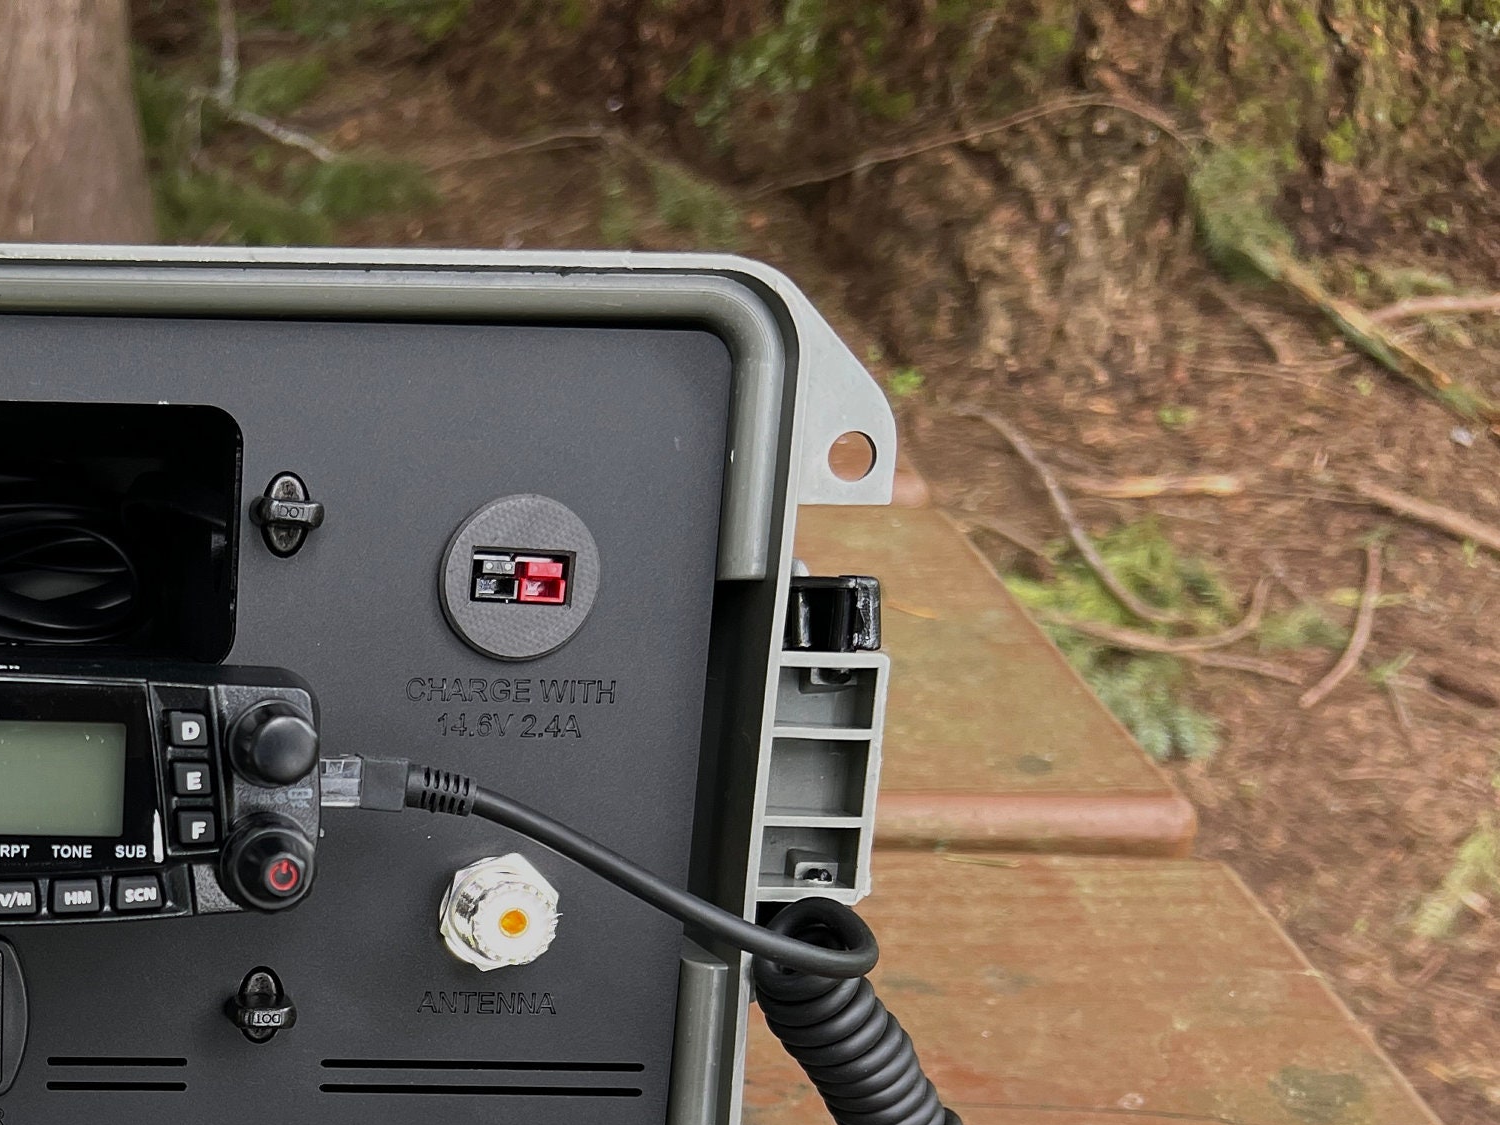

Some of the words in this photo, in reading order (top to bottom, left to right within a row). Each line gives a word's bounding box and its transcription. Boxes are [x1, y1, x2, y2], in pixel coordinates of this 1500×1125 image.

[405, 677, 532, 703] CHARGE
[540, 680, 617, 704] WITH
[181, 720, 201, 741] D
[437, 713, 514, 737] 14.6V
[520, 714, 582, 739] 2.4A
[186, 771, 202, 790] E
[191, 821, 207, 840] F
[0, 844, 30, 858] RPT
[51, 844, 93, 859] TONE
[115, 844, 147, 858] SUB
[64, 889, 92, 906] HM
[124, 886, 157, 903] SCN
[417, 991, 557, 1015] ANTENNA
